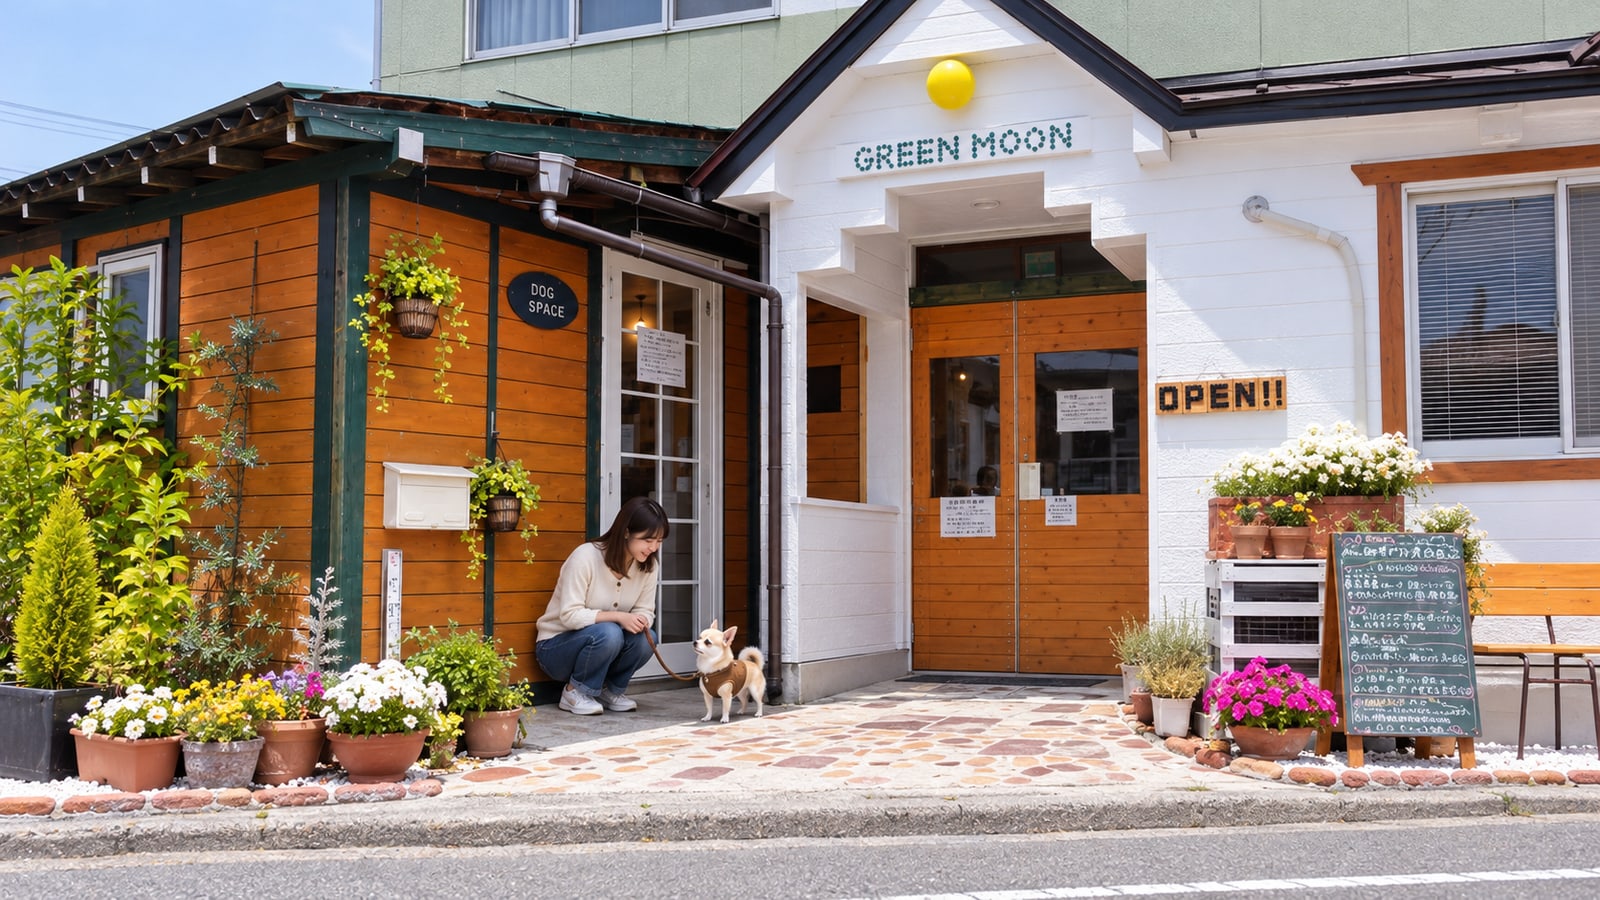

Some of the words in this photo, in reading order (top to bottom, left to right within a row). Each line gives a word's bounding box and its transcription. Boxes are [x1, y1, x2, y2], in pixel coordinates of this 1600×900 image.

[854, 135, 960, 172] GREEN
[971, 122, 1072, 159] MOON
[531, 283, 555, 299] DOG
[528, 300, 565, 318] SPACE
[1159, 379, 1283, 411] OPEN!!
